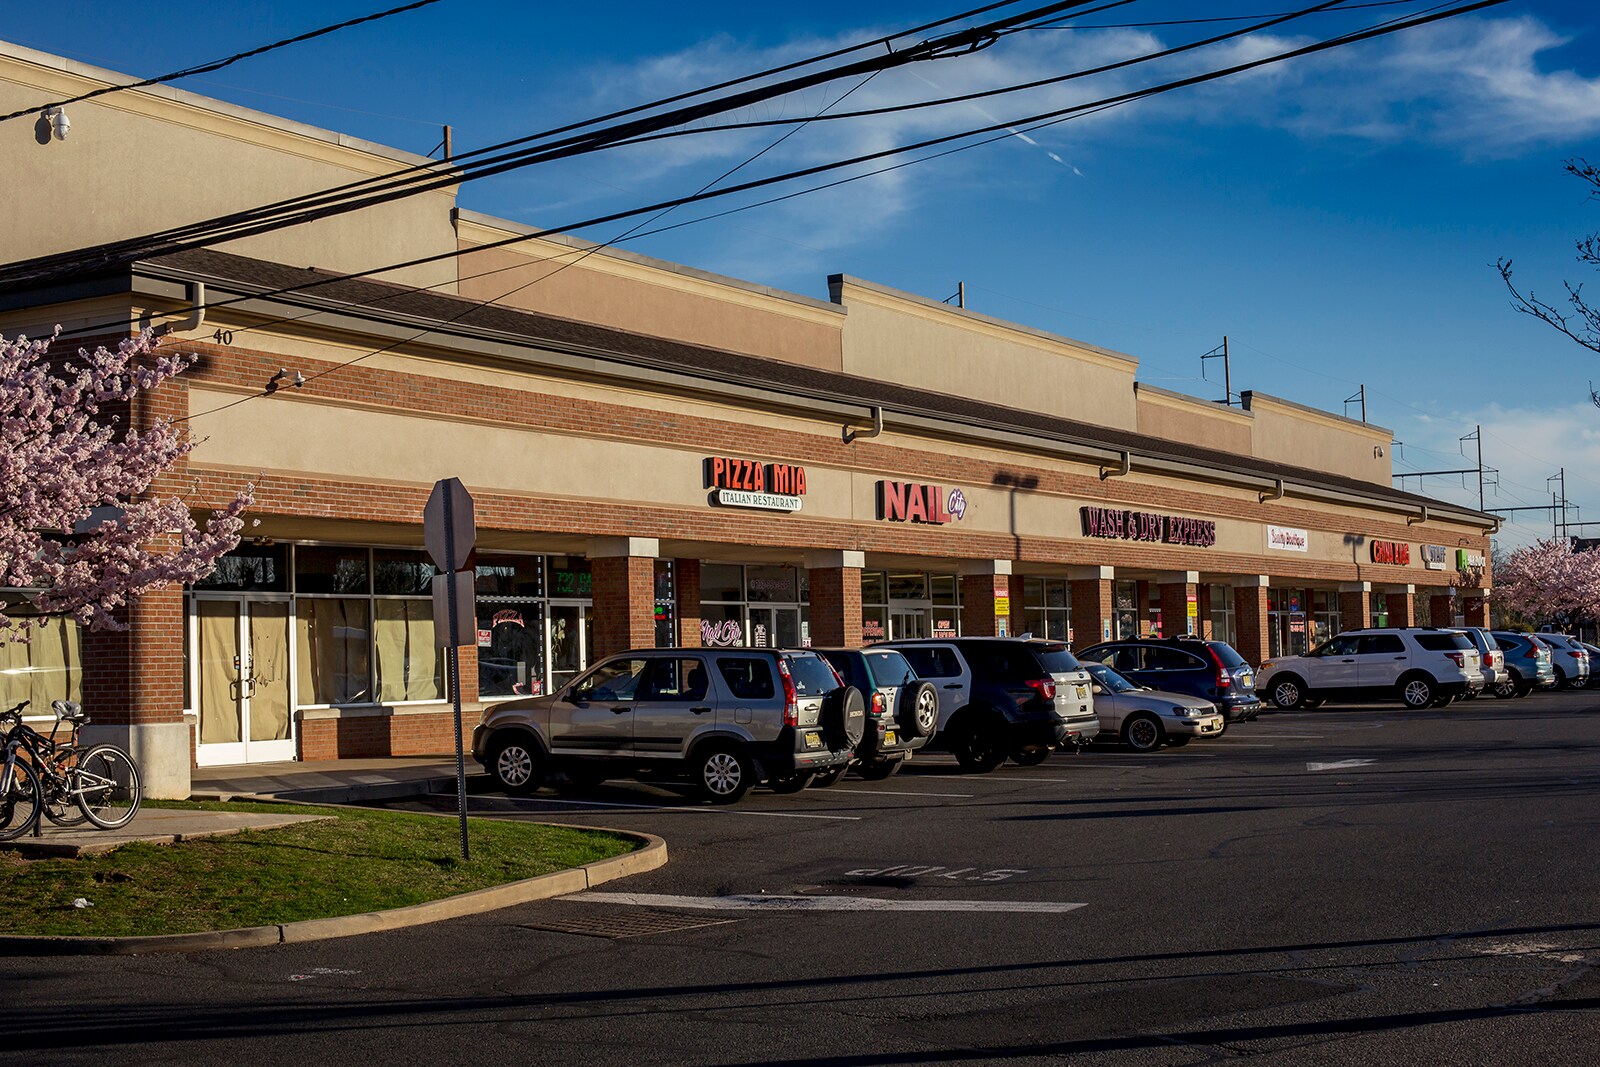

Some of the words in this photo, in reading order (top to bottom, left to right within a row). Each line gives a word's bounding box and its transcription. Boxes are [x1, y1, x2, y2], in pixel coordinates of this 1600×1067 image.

[213, 328, 233, 345] 40
[712, 456, 766, 492] PIZZA
[773, 463, 807, 496] MIA
[722, 492, 752, 505] ITALIAN
[753, 495, 799, 510] RESTAURANT
[884, 479, 952, 523] NAIL
[948, 488, 968, 522] City
[1087, 506, 1125, 538] WASH
[1127, 511, 1137, 538] &
[1139, 512, 1164, 541] DRY
[1168, 516, 1216, 546] EXPRESS
[554, 571, 575, 592] 732
[492, 609, 526, 628] PIZZA
[700, 618, 722, 647] Nail
[720, 618, 742, 647] City
[844, 864, 1029, 882] STOP
